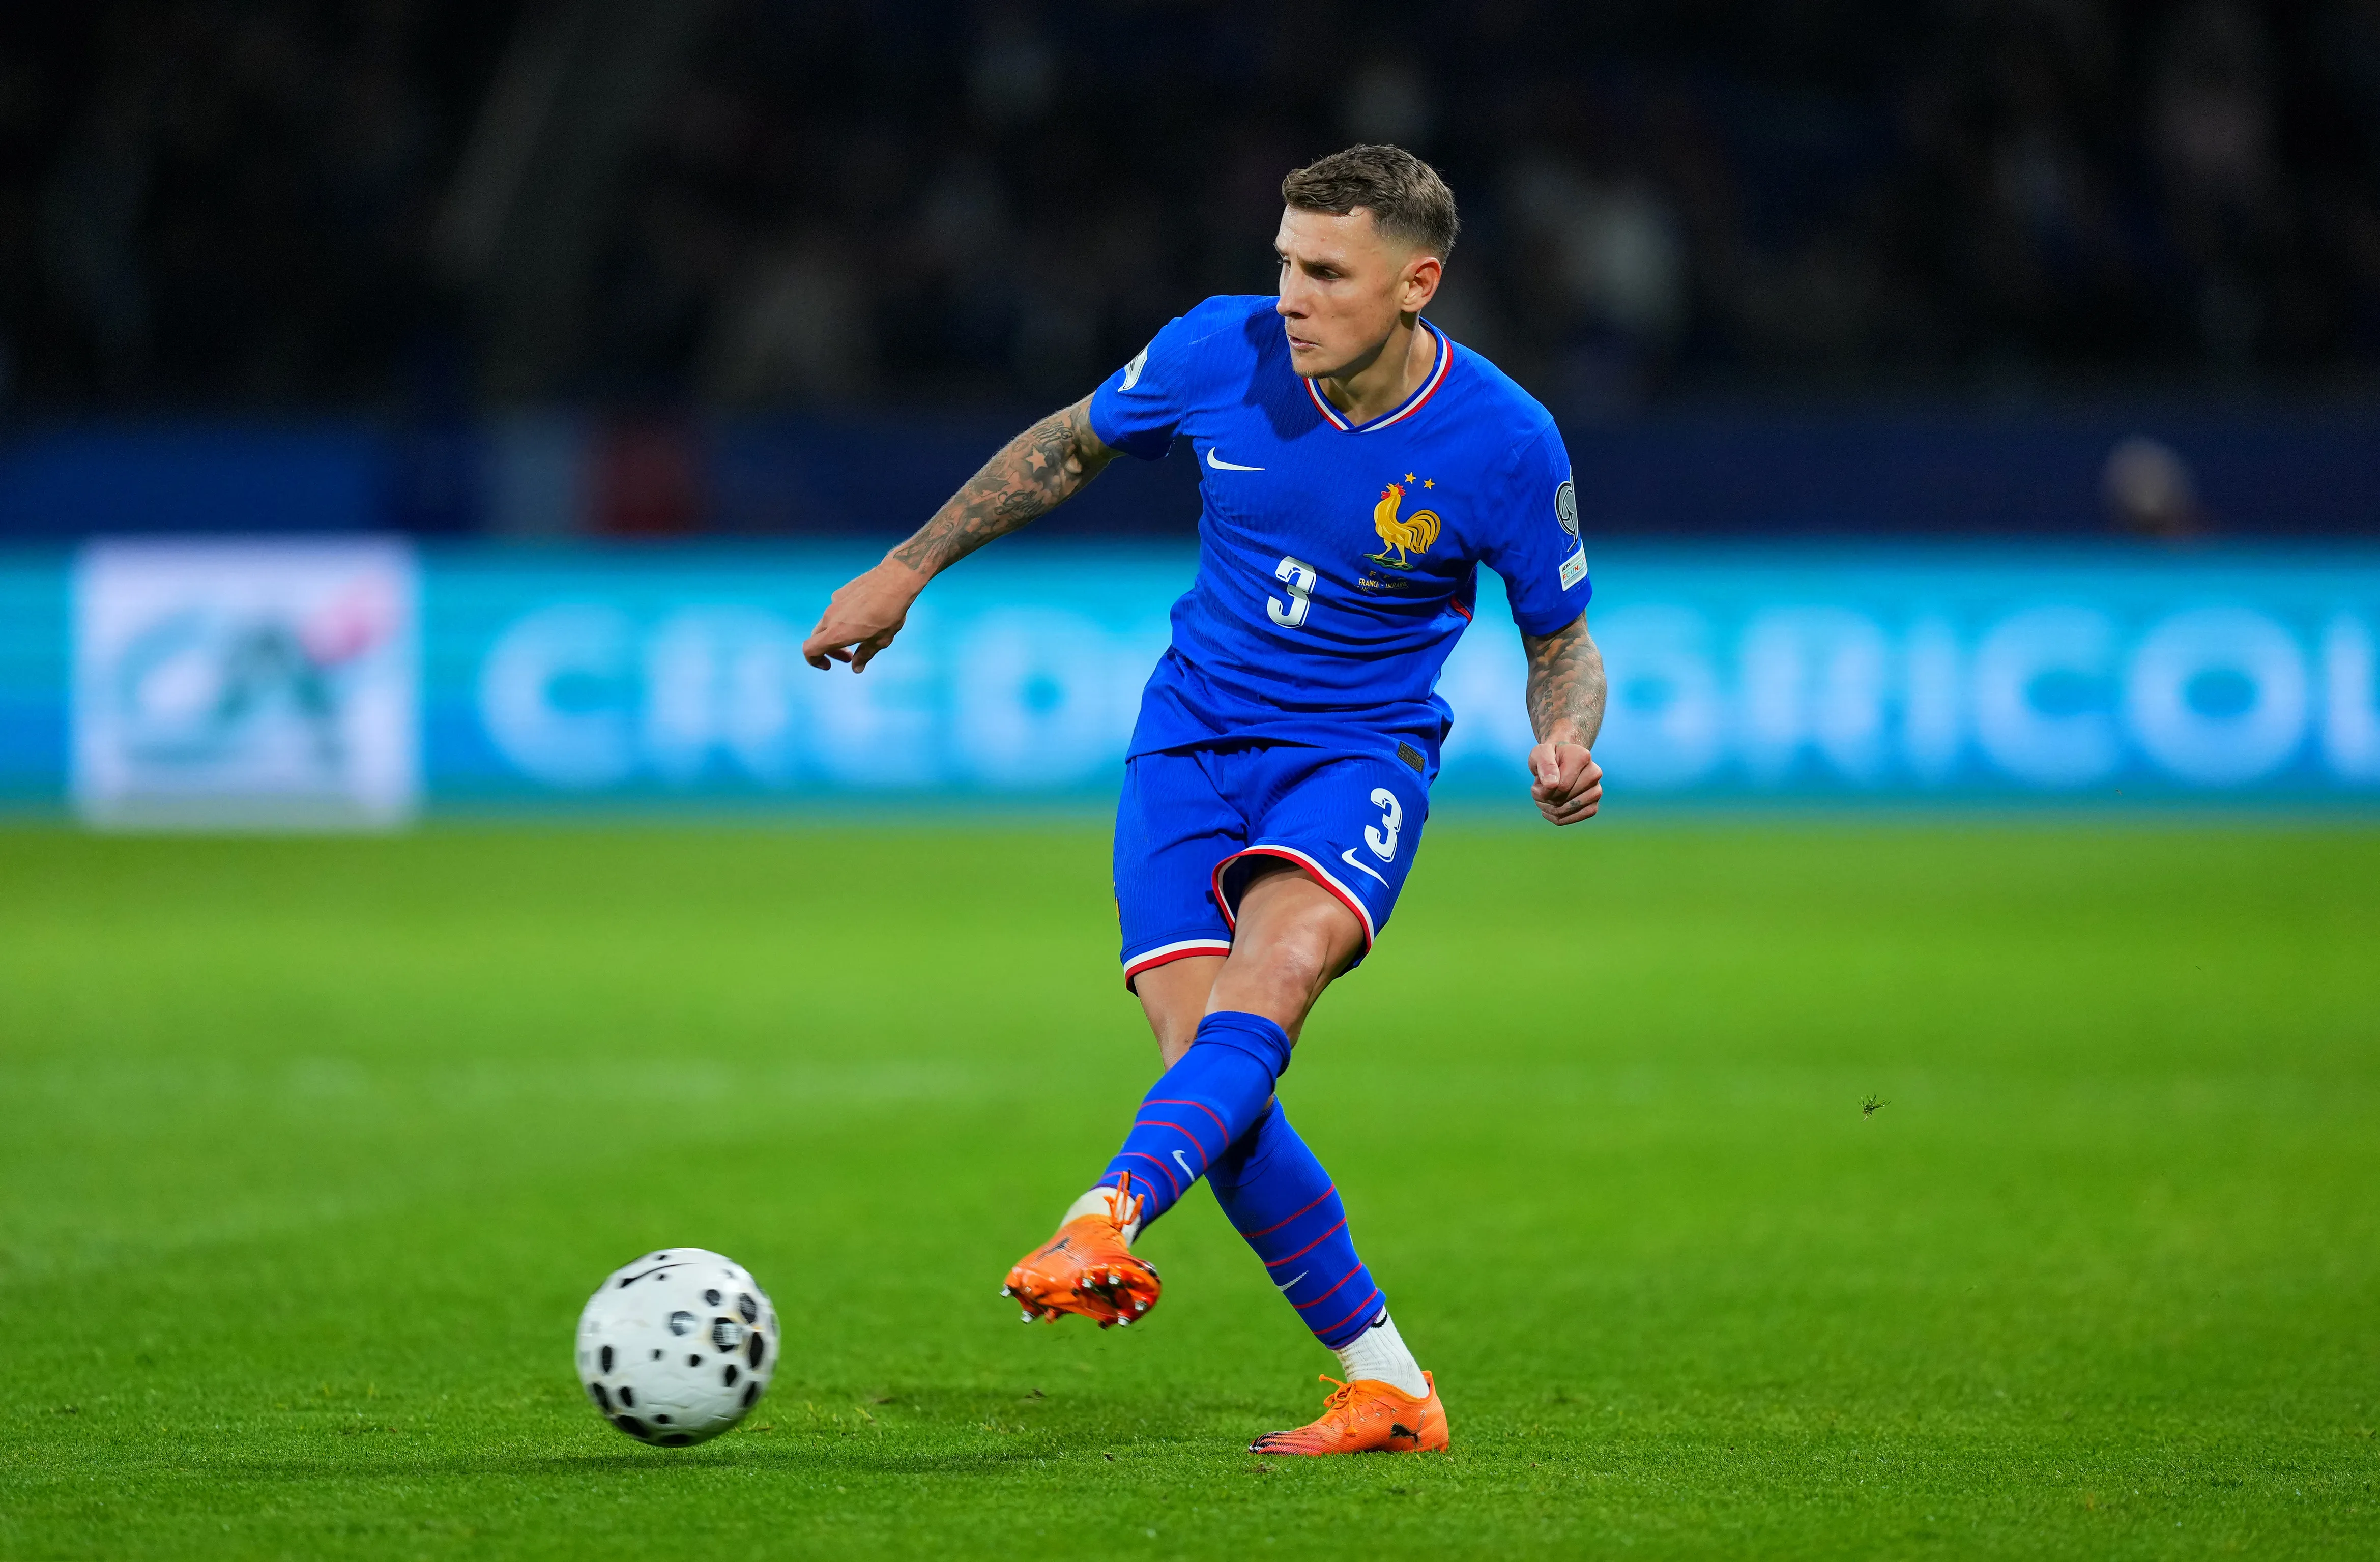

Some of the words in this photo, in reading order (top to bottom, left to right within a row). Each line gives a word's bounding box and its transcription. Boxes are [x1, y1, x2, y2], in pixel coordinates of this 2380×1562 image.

[1358, 578, 1380, 588] FRANCE
[1561, 562, 1571, 572] UEFA
[1562, 557, 1586, 581] FOUNDA
[1267, 556, 1316, 628] 3
[481, 605, 1163, 781] CRED
[1364, 788, 1402, 862] 3
